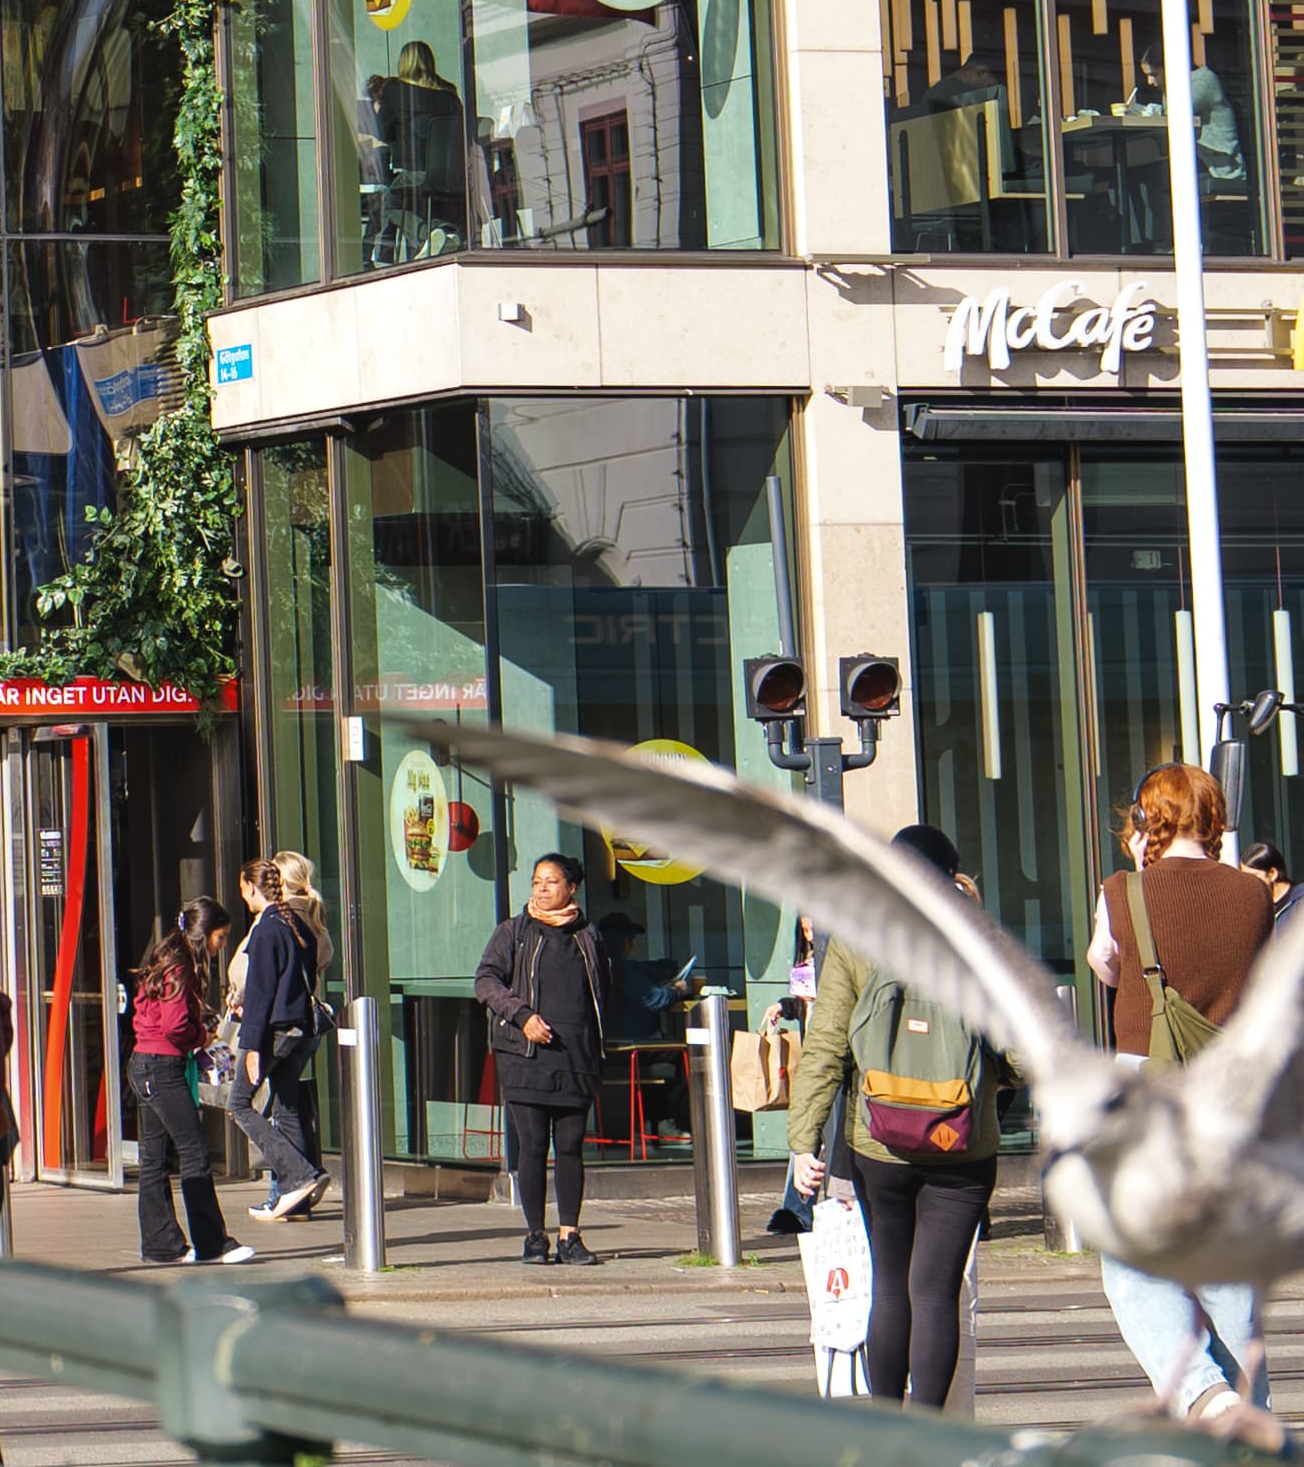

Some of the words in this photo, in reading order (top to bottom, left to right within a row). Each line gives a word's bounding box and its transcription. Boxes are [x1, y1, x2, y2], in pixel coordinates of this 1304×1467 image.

[943, 280, 1155, 372] McCafé
[25, 686, 87, 705] INGET
[92, 685, 145, 704] UTAN
